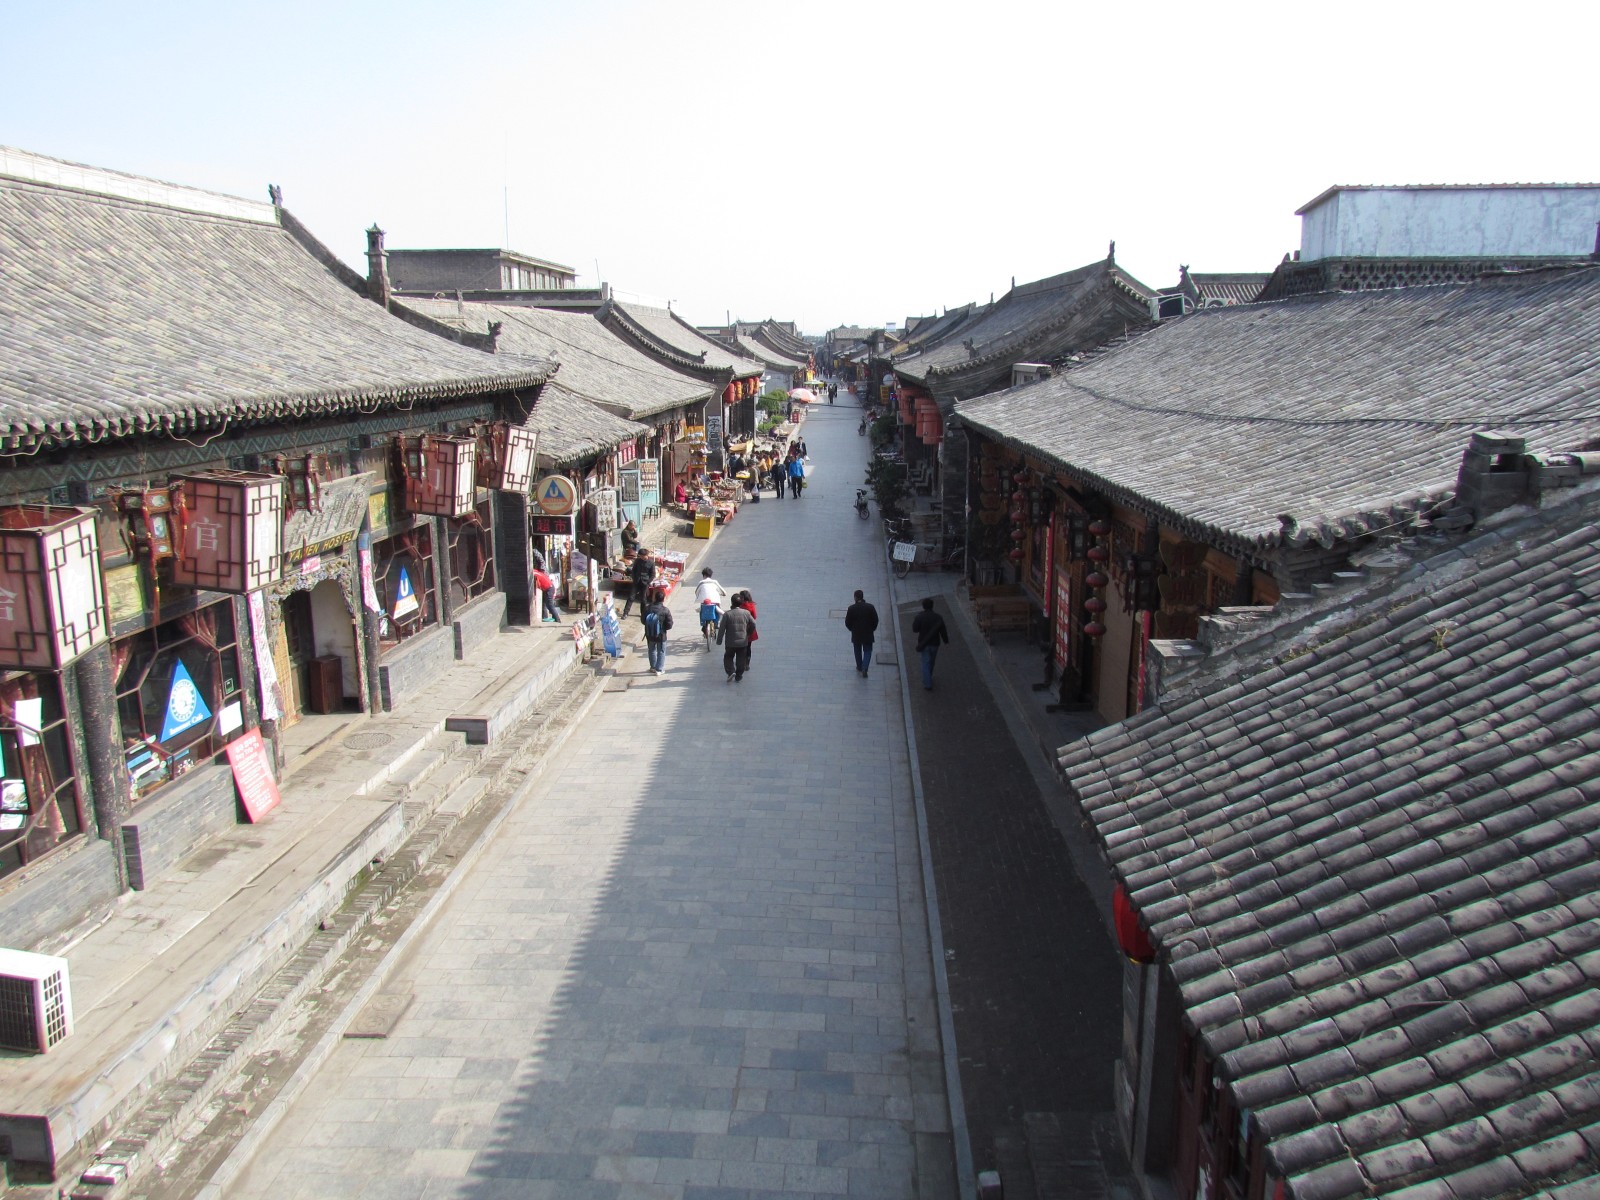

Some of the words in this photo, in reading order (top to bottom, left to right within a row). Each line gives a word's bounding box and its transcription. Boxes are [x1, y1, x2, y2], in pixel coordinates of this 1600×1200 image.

[550, 486, 558, 497] U
[191, 517, 223, 551] 官
[536, 519, 567, 532] 超市
[323, 533, 354, 550] HOSTEL
[400, 578, 409, 597] U
